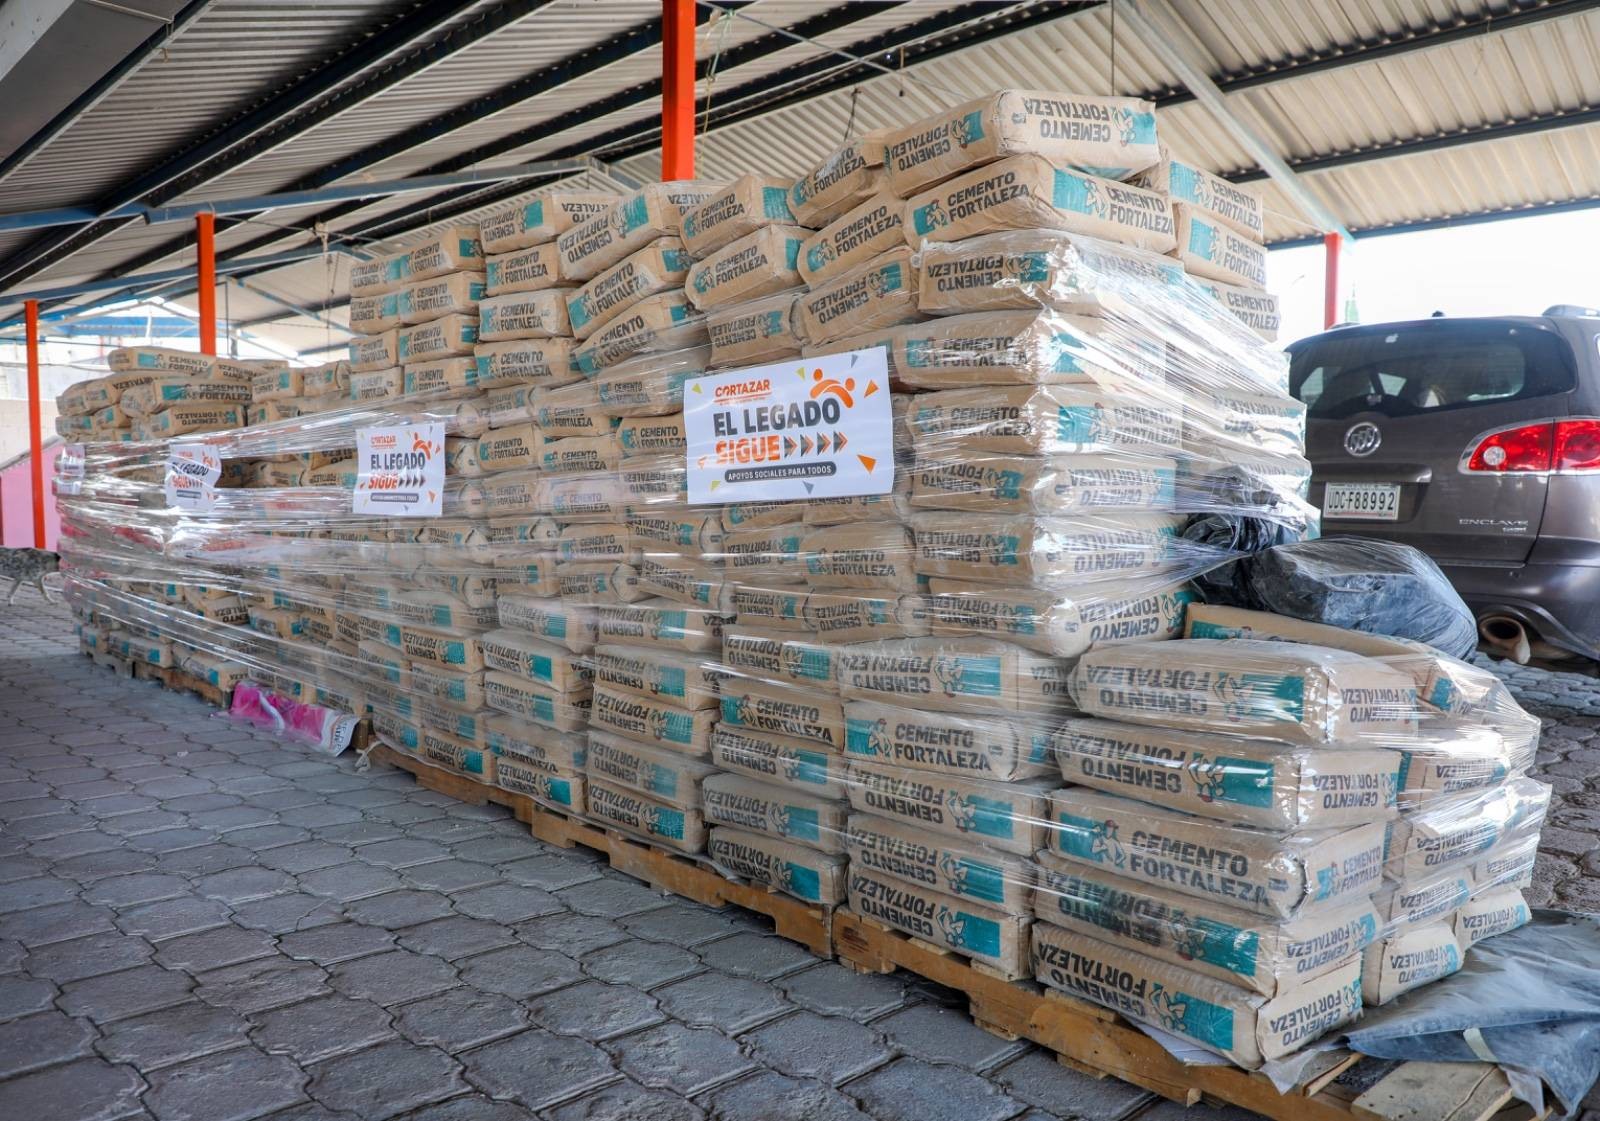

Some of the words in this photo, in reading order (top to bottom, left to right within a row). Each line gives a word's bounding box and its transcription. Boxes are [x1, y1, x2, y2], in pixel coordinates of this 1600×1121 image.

[1024, 98, 1109, 120] FORTALEZA
[1040, 119, 1111, 142] CEMENTO
[898, 141, 951, 170] CEMENTO
[947, 172, 1015, 205] CEMENTO
[1106, 186, 1165, 212] CEMENTO
[1211, 180, 1257, 212] CEMENTO
[701, 193, 736, 218] CEMENTO
[949, 184, 1029, 222] FORTALEZA
[701, 204, 745, 234] FORTALEZA
[834, 206, 887, 244] CEMENTO
[1110, 204, 1174, 235] FORTALEZA
[568, 231, 612, 263] CEMENTO
[837, 214, 901, 257] FORTALEZA
[716, 245, 758, 273] CEMENTO
[716, 254, 768, 286] FORTALEZA
[929, 256, 1003, 277] FORTALEZA
[505, 264, 548, 283] FORTALEZA
[594, 262, 634, 297] CEMENTO
[938, 271, 1002, 291] CEMENTO
[808, 277, 867, 314] FORTALEZA
[819, 291, 869, 325] CEMENTO
[501, 351, 543, 364] CEMENTO
[715, 380, 770, 396] CORTAZAR
[554, 417, 592, 427] FORTALEZA
[714, 412, 737, 437] EL
[744, 398, 840, 433] LEGADO
[494, 439, 522, 449] CEMENTO
[640, 426, 678, 437] CEMENTO
[371, 454, 381, 469] EL
[385, 452, 425, 470] LEGADO
[494, 448, 530, 459] FORTALEZA
[715, 435, 780, 464] SIGUE
[369, 473, 397, 489] SIGUE
[728, 472, 754, 481] APOYOS
[755, 469, 786, 479] SOCIALES
[788, 468, 806, 476] PARA
[807, 466, 831, 474] TODOS
[1090, 617, 1160, 641] CEMENTO
[729, 653, 780, 672] CEMENTO
[600, 670, 643, 689] CEMENTO
[853, 674, 930, 693] CEMENTO
[1085, 665, 1211, 691] FORTALEZA
[1099, 687, 1208, 715] CEMENTO
[1340, 687, 1399, 704] FORTALEZA
[756, 700, 819, 723] CEMENTO
[756, 716, 832, 743] FORTALEZA
[895, 723, 973, 748] CEMENTO
[894, 744, 992, 771] FORTALEZA
[594, 757, 637, 788] CEMENTO
[1082, 758, 1182, 793] CEMENTO
[1312, 774, 1379, 793] FORTALEZA
[865, 791, 943, 823] CEMENTO
[1321, 790, 1378, 808] CEMENTO
[593, 802, 639, 827] CEMENTO
[1132, 829, 1249, 877] CEMENTO
[861, 851, 936, 884] CEMENTO
[1130, 854, 1270, 907] FORTALEZA
[851, 875, 935, 920] FORTALEZA
[861, 899, 933, 937] CEMENTO
[1463, 908, 1509, 928] FORTALEZA
[1286, 922, 1350, 958] FORTALEZA
[1038, 941, 1148, 997] FORTALEZA
[1297, 943, 1349, 974] CEMENTO
[1391, 947, 1439, 969] FORTALEZA
[1052, 969, 1145, 1016] CEMENTO
[1271, 992, 1341, 1033] FORTALEZA
[1283, 1010, 1341, 1046] CEMENTO
